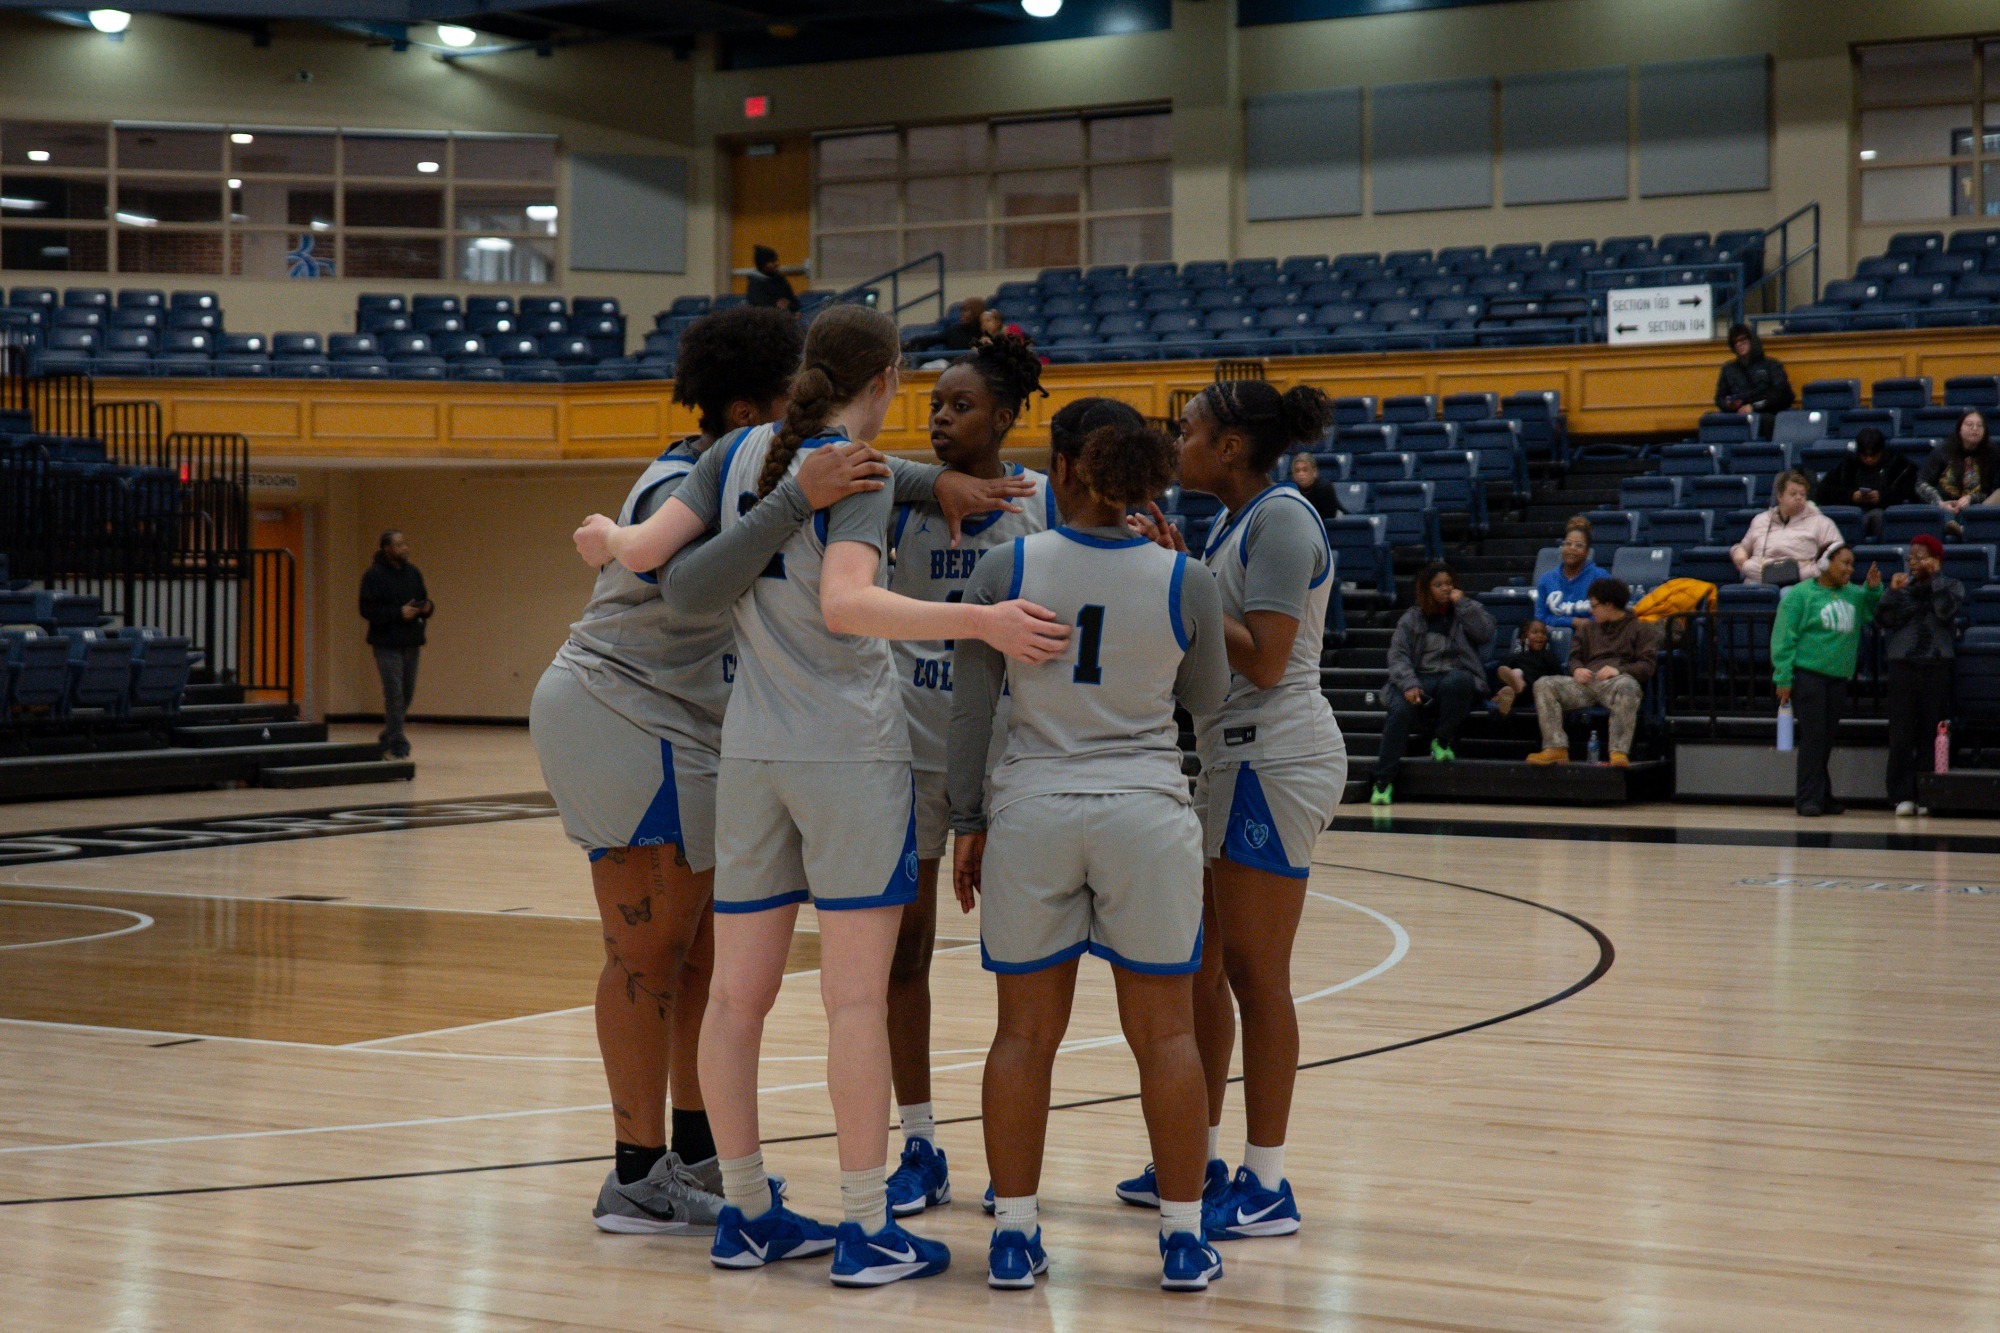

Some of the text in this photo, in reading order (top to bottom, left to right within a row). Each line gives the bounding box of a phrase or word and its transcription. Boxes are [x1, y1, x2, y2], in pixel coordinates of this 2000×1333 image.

[1613, 297, 1670, 312] SECTION 103
[1648, 319, 1705, 333] SECTION 104
[1073, 603, 1105, 686] 1
